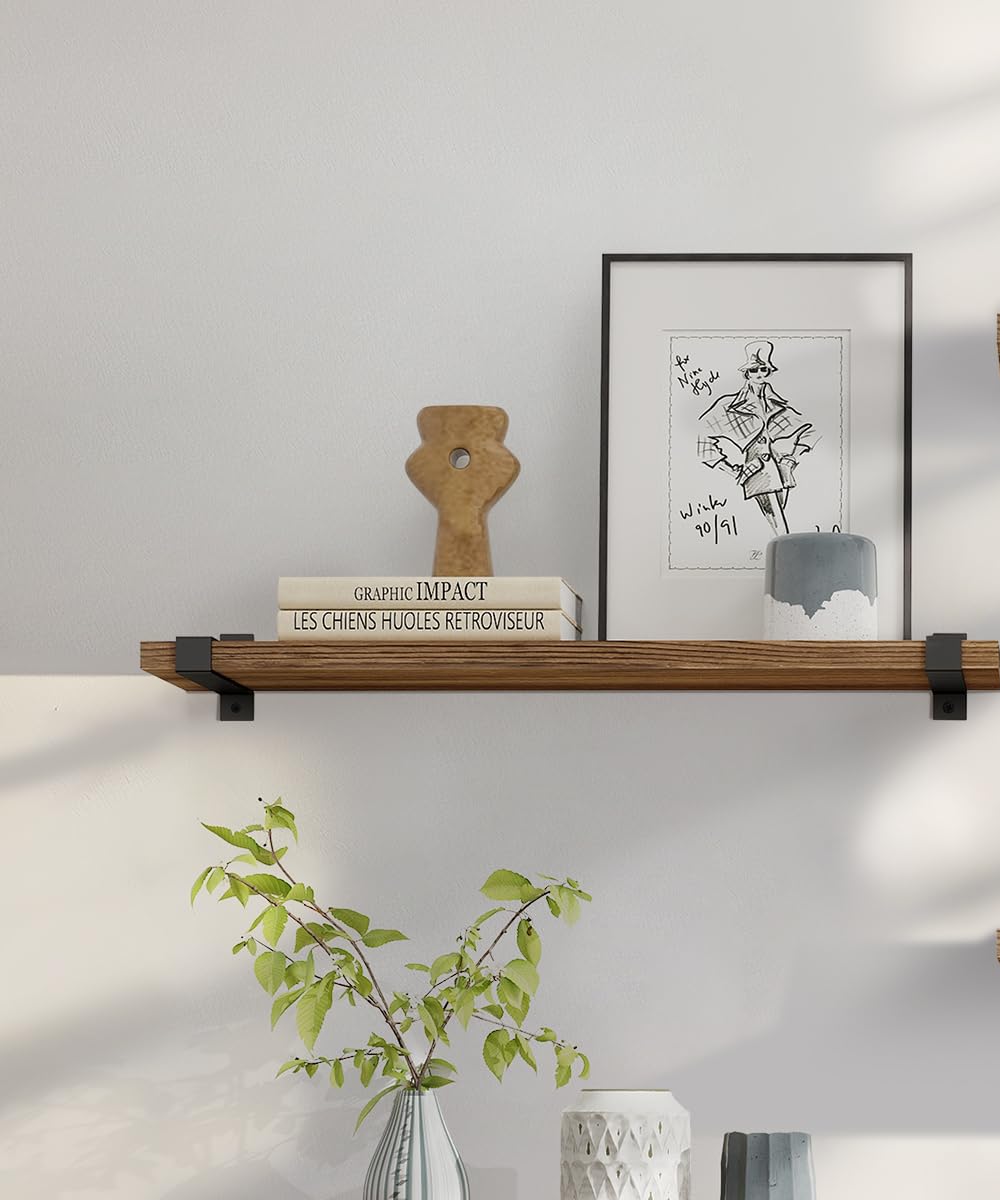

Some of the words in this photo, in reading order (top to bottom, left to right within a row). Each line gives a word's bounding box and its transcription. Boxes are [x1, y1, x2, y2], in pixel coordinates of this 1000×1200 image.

[695, 514, 738, 544] 90/91
[354, 586, 413, 600] GRAPHIC
[416, 581, 488, 600] IMPACT
[294, 612, 318, 630] LES
[322, 612, 376, 630] CHIENS
[382, 612, 440, 630] HUOLES
[446, 612, 545, 630] RETROVISEUR
